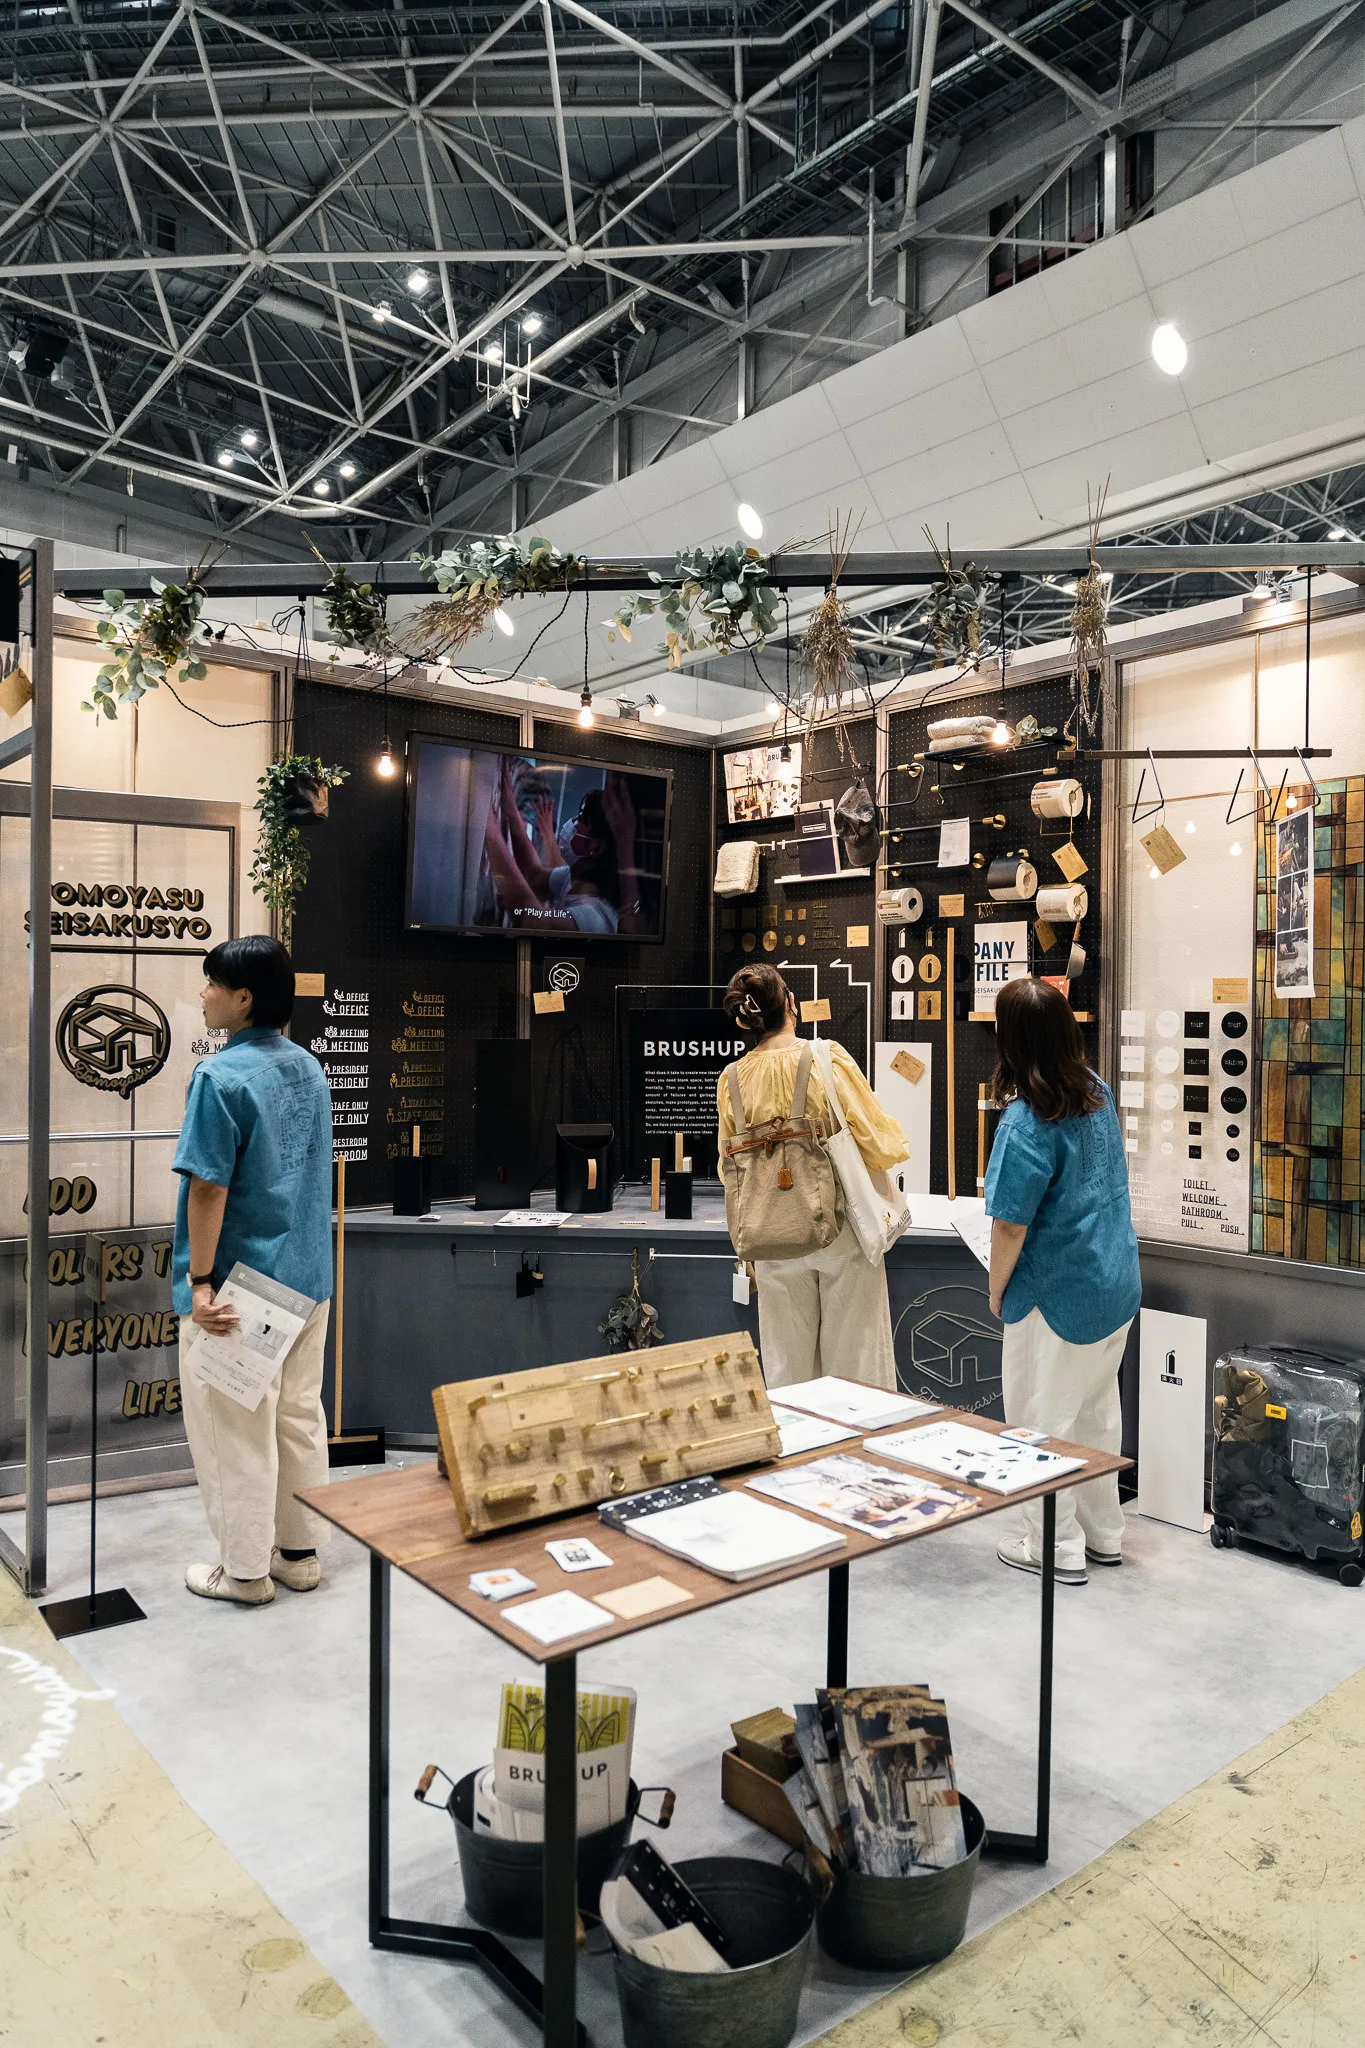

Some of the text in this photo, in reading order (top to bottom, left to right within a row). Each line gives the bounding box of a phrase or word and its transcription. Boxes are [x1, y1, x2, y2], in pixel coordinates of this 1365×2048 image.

[51, 882, 204, 911] OMOYASU
[514, 908, 522, 916] or
[524, 907, 543, 918] "Play
[24, 911, 212, 940] EISAKUSYO
[976, 963, 1009, 981] FILE
[346, 992, 369, 1001] OFFICE
[339, 1005, 369, 1015] OFFICE
[417, 1005, 445, 1015] OFFICE
[339, 1029, 369, 1037] MEETING
[331, 1041, 369, 1051] MEETING
[410, 1041, 445, 1050] MEETING
[644, 1040, 746, 1057] BRUSHUP
[332, 1065, 369, 1073] PRESIDENT
[73, 1059, 161, 1101] Tomoyasu
[328, 1077, 369, 1087] RESIDENT
[400, 1075, 444, 1086] PRESIDENT
[352, 1101, 368, 1109] ONLY
[347, 1113, 369, 1124] ONLY
[332, 1137, 368, 1146] RESTROOM
[333, 1149, 368, 1161] STROOM
[1183, 1178, 1209, 1190] TOILET
[23, 1176, 97, 1215] DD
[1182, 1192, 1220, 1205] WELCOME
[1181, 1205, 1222, 1219] BATHROOM
[1181, 1218, 1198, 1228] PULL
[1220, 1224, 1239, 1234] PUSH
[23, 1242, 144, 1287] OLRS
[152, 1241, 174, 1278] T
[22, 1310, 181, 1358] VERYONE
[509, 1763, 608, 1785] BRUUP
